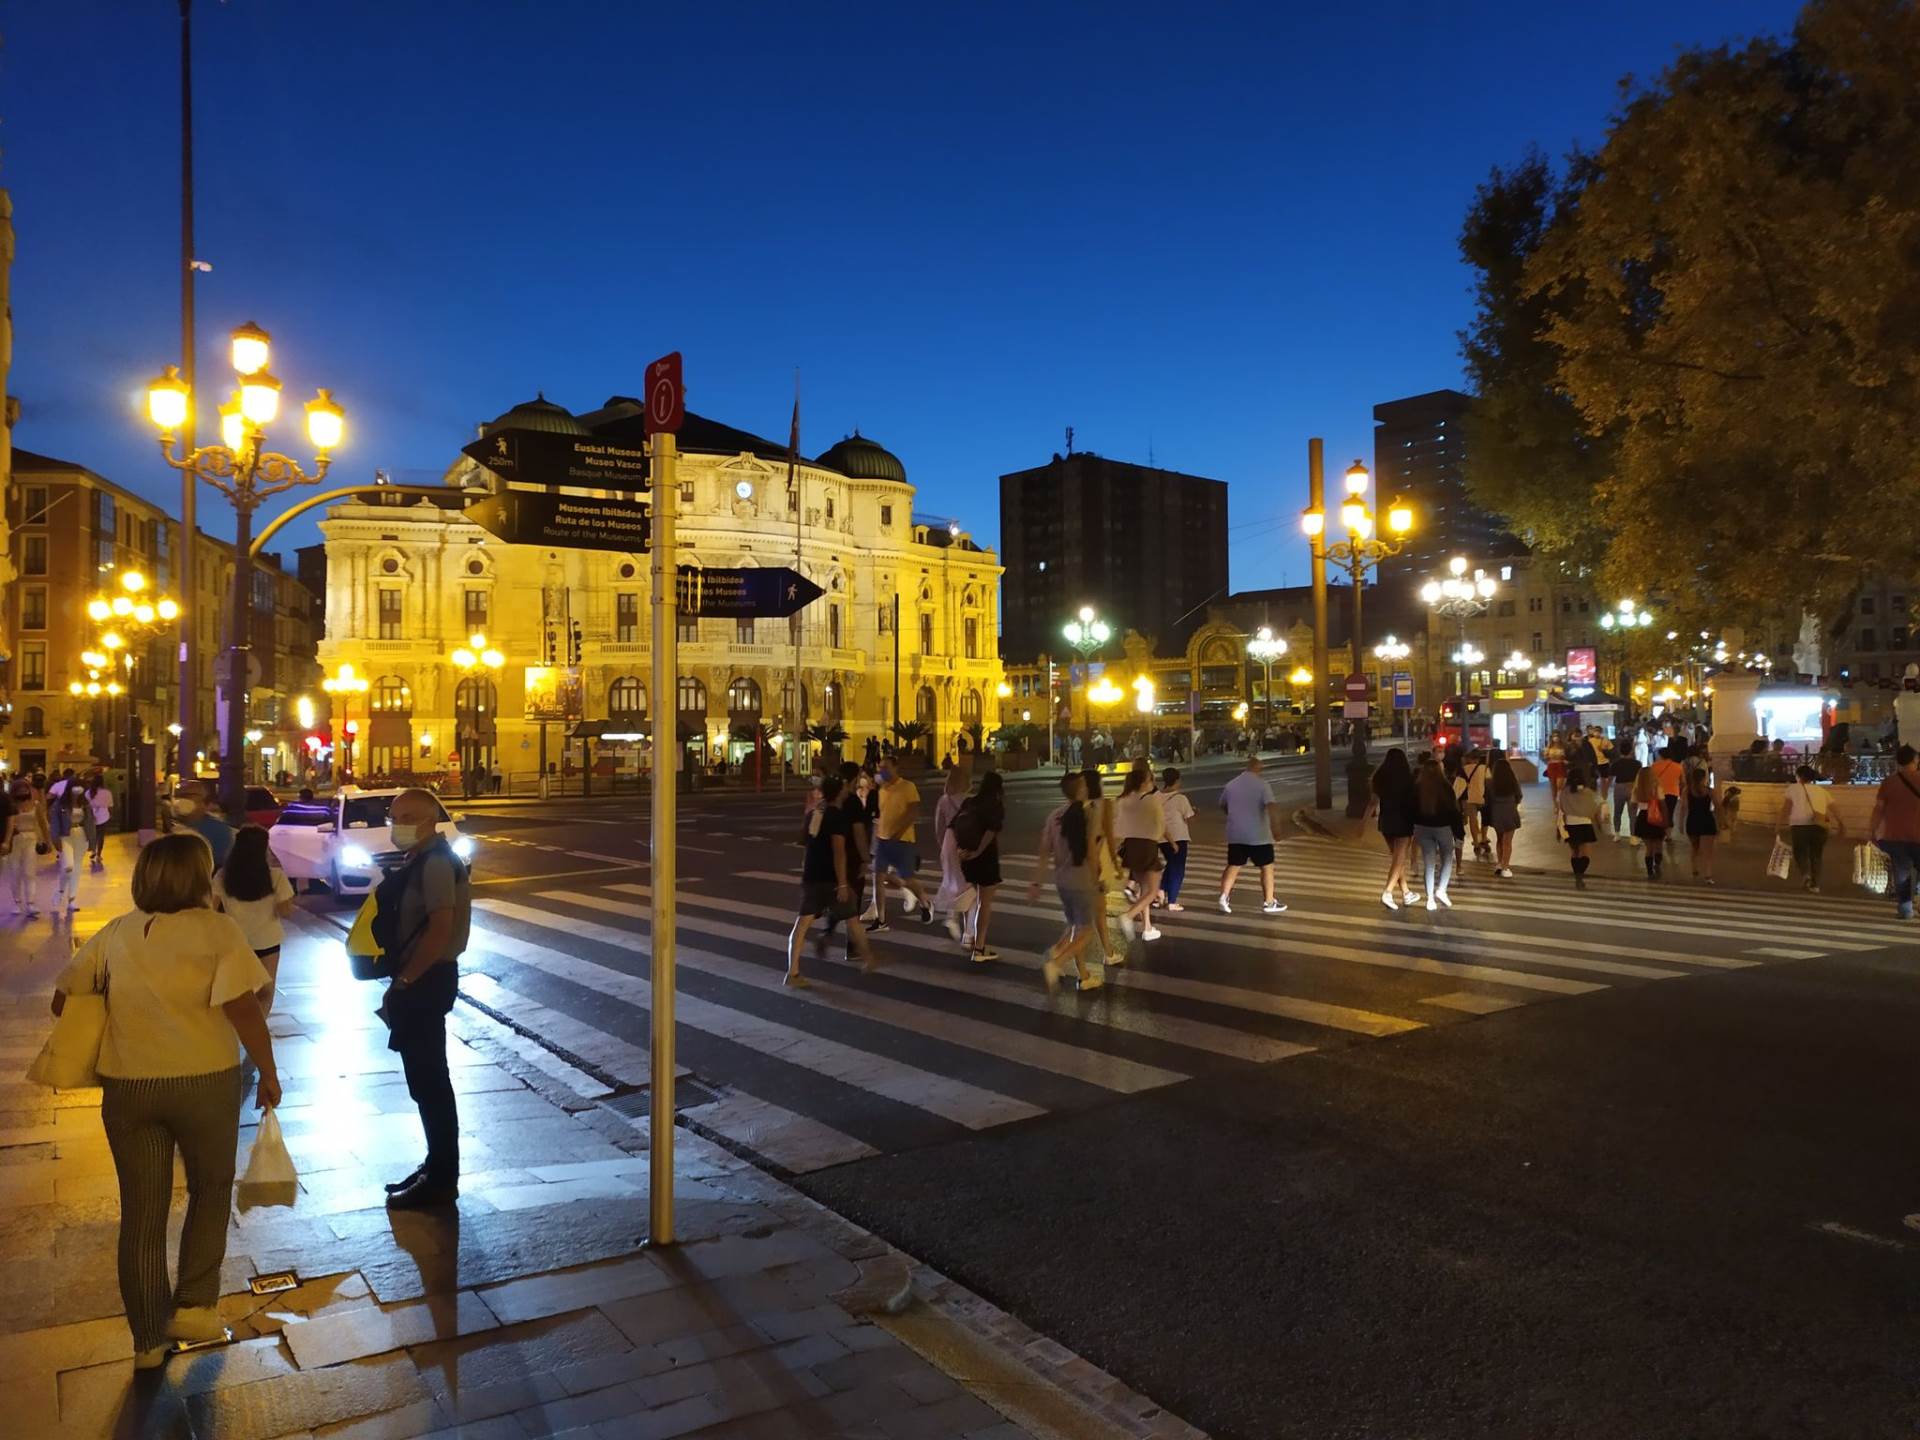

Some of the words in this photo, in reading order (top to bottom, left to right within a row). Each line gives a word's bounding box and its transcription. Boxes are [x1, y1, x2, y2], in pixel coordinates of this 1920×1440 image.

[574, 442, 605, 454] Euskal
[607, 445, 641, 457] Museoa
[585, 456, 615, 467] Museo
[616, 459, 642, 469] Vasco
[569, 467, 602, 479] Basque
[604, 470, 641, 481] Museum
[559, 503, 600, 515] Museoen
[602, 507, 642, 519] Ibilbidea
[555, 515, 577, 526] Ruta
[578, 517, 591, 527] de
[592, 518, 605, 528] los
[607, 520, 642, 531] Museos
[543, 526, 570, 537] Route
[571, 527, 581, 538] of
[582, 529, 597, 539] the
[599, 531, 642, 543] Museums
[707, 575, 744, 584] Ibilbidea
[715, 587, 748, 597] Museos
